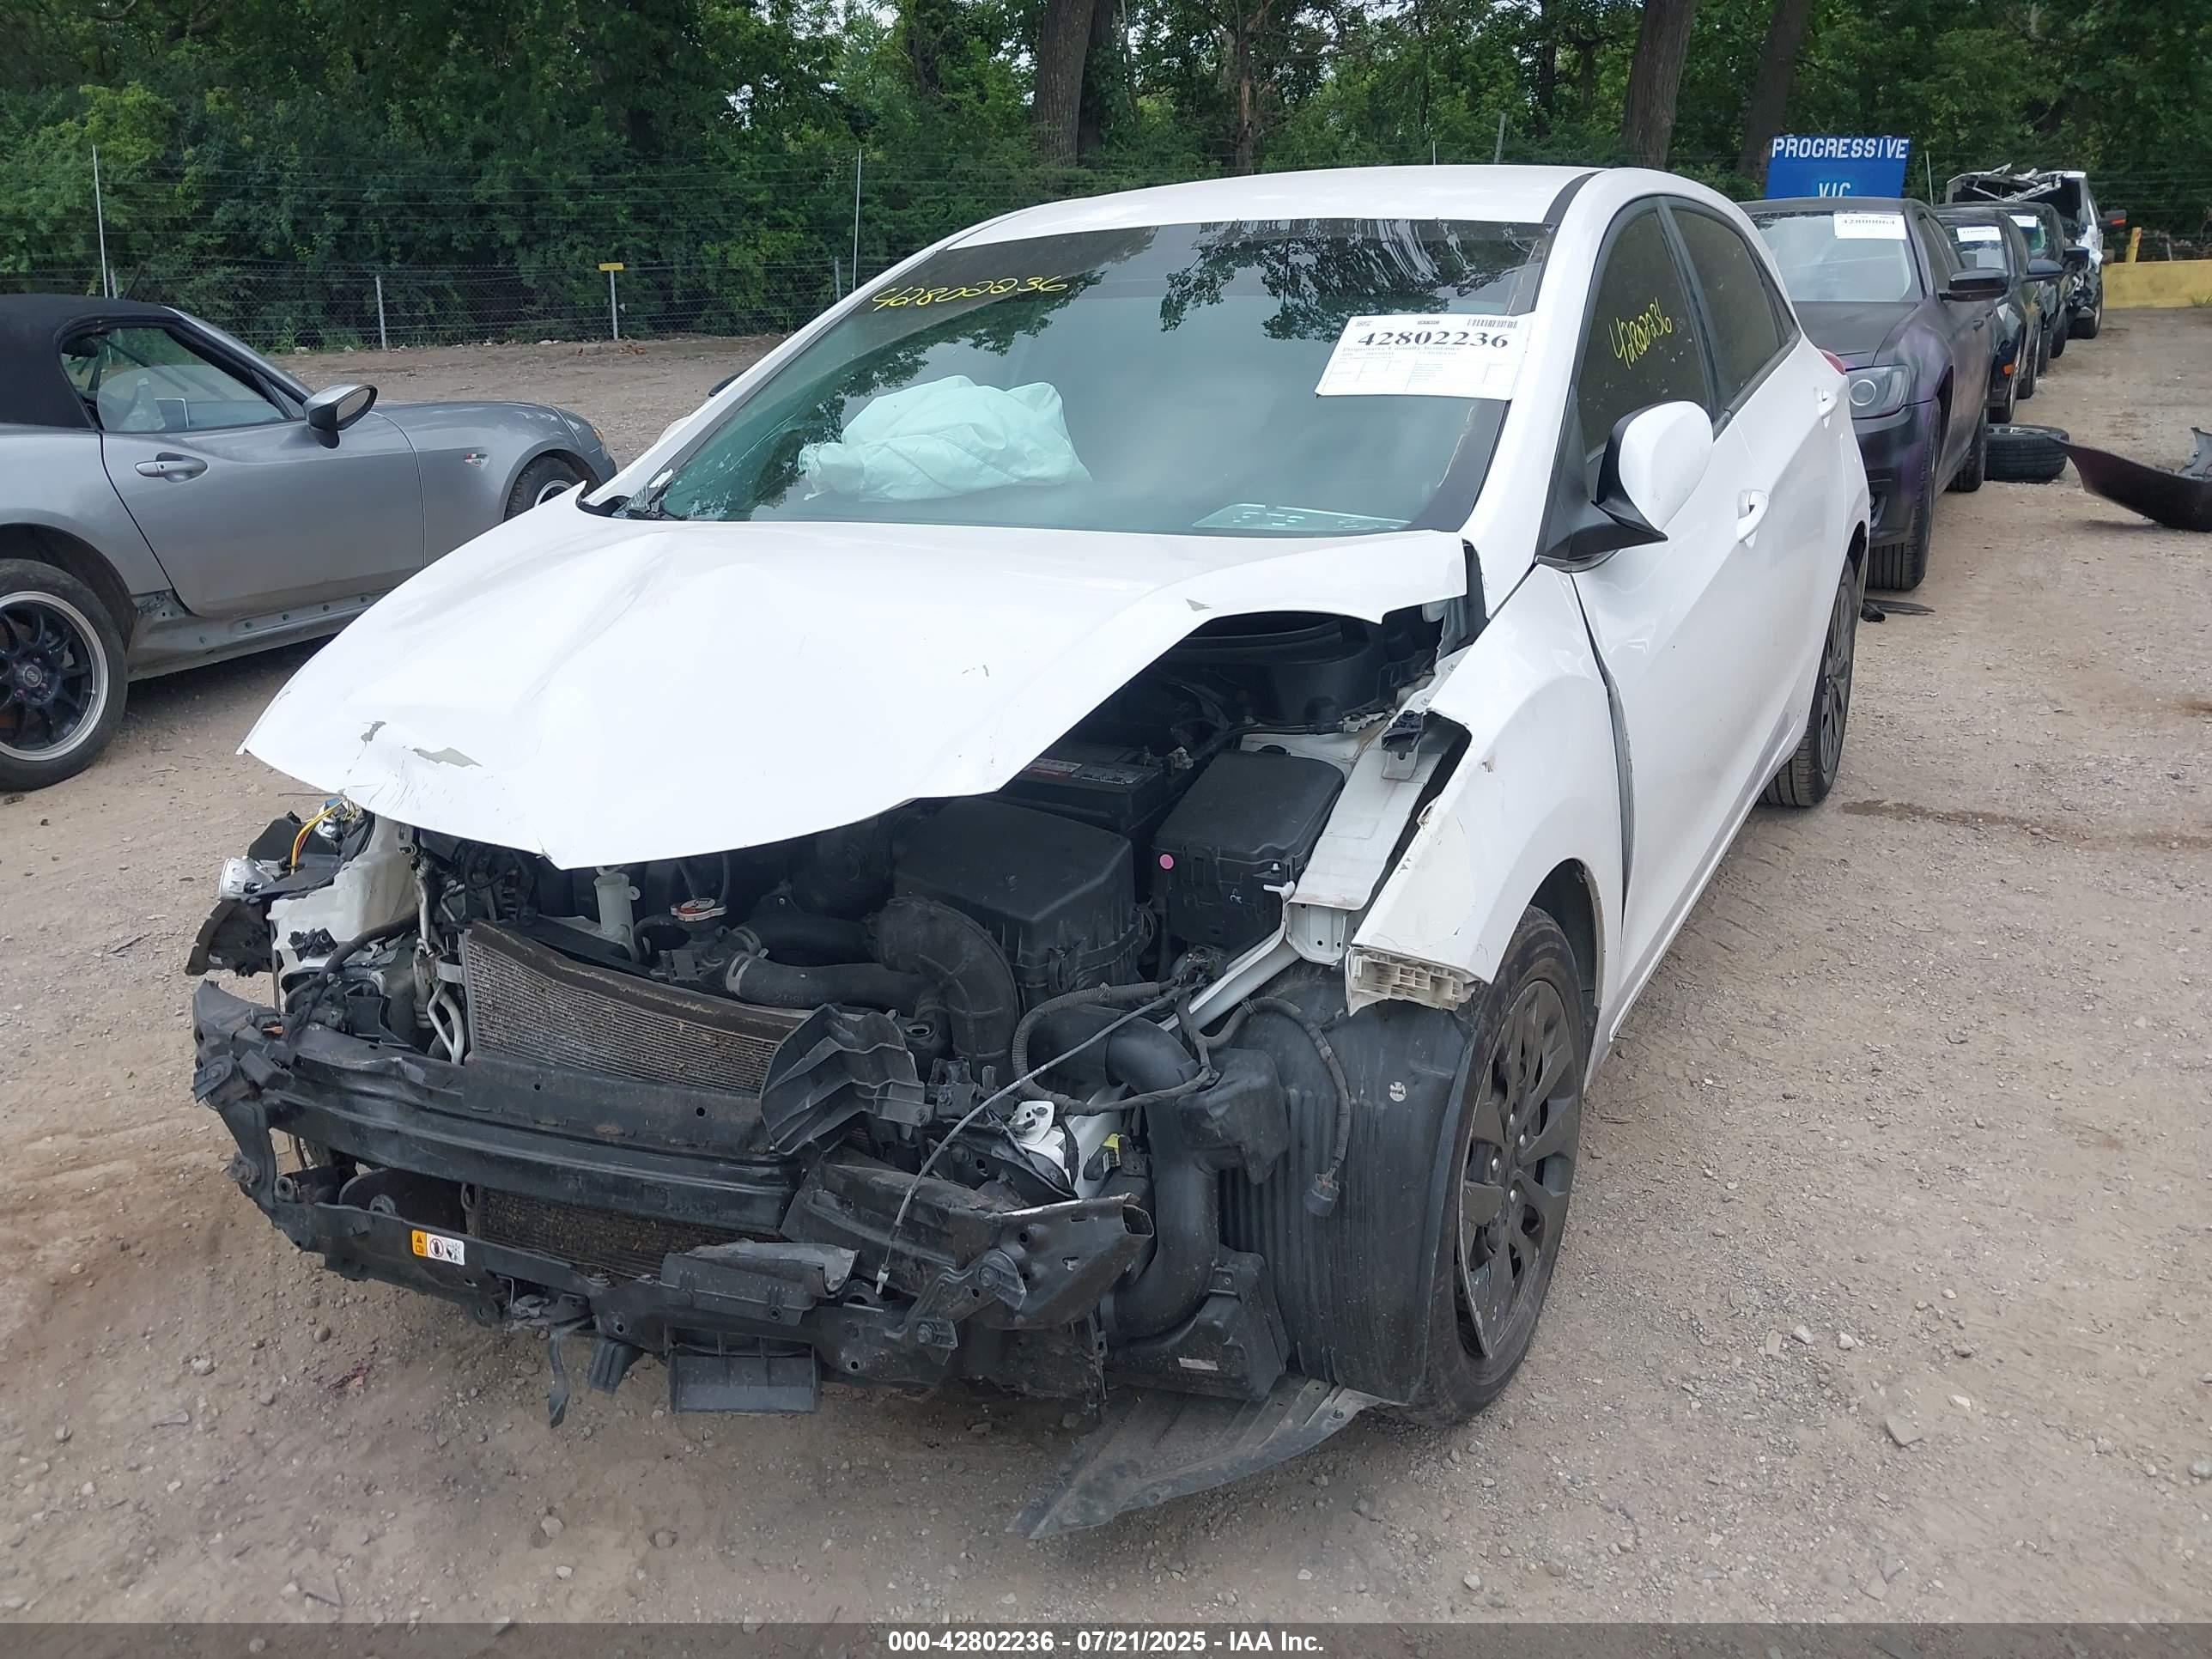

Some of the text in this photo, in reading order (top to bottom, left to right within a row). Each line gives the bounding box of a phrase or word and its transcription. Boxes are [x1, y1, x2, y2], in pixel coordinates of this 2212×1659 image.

[1771, 137, 1909, 159] PROGRESSIVE
[872, 275, 1068, 313] 42802236
[1357, 330, 1510, 349] 42802236
